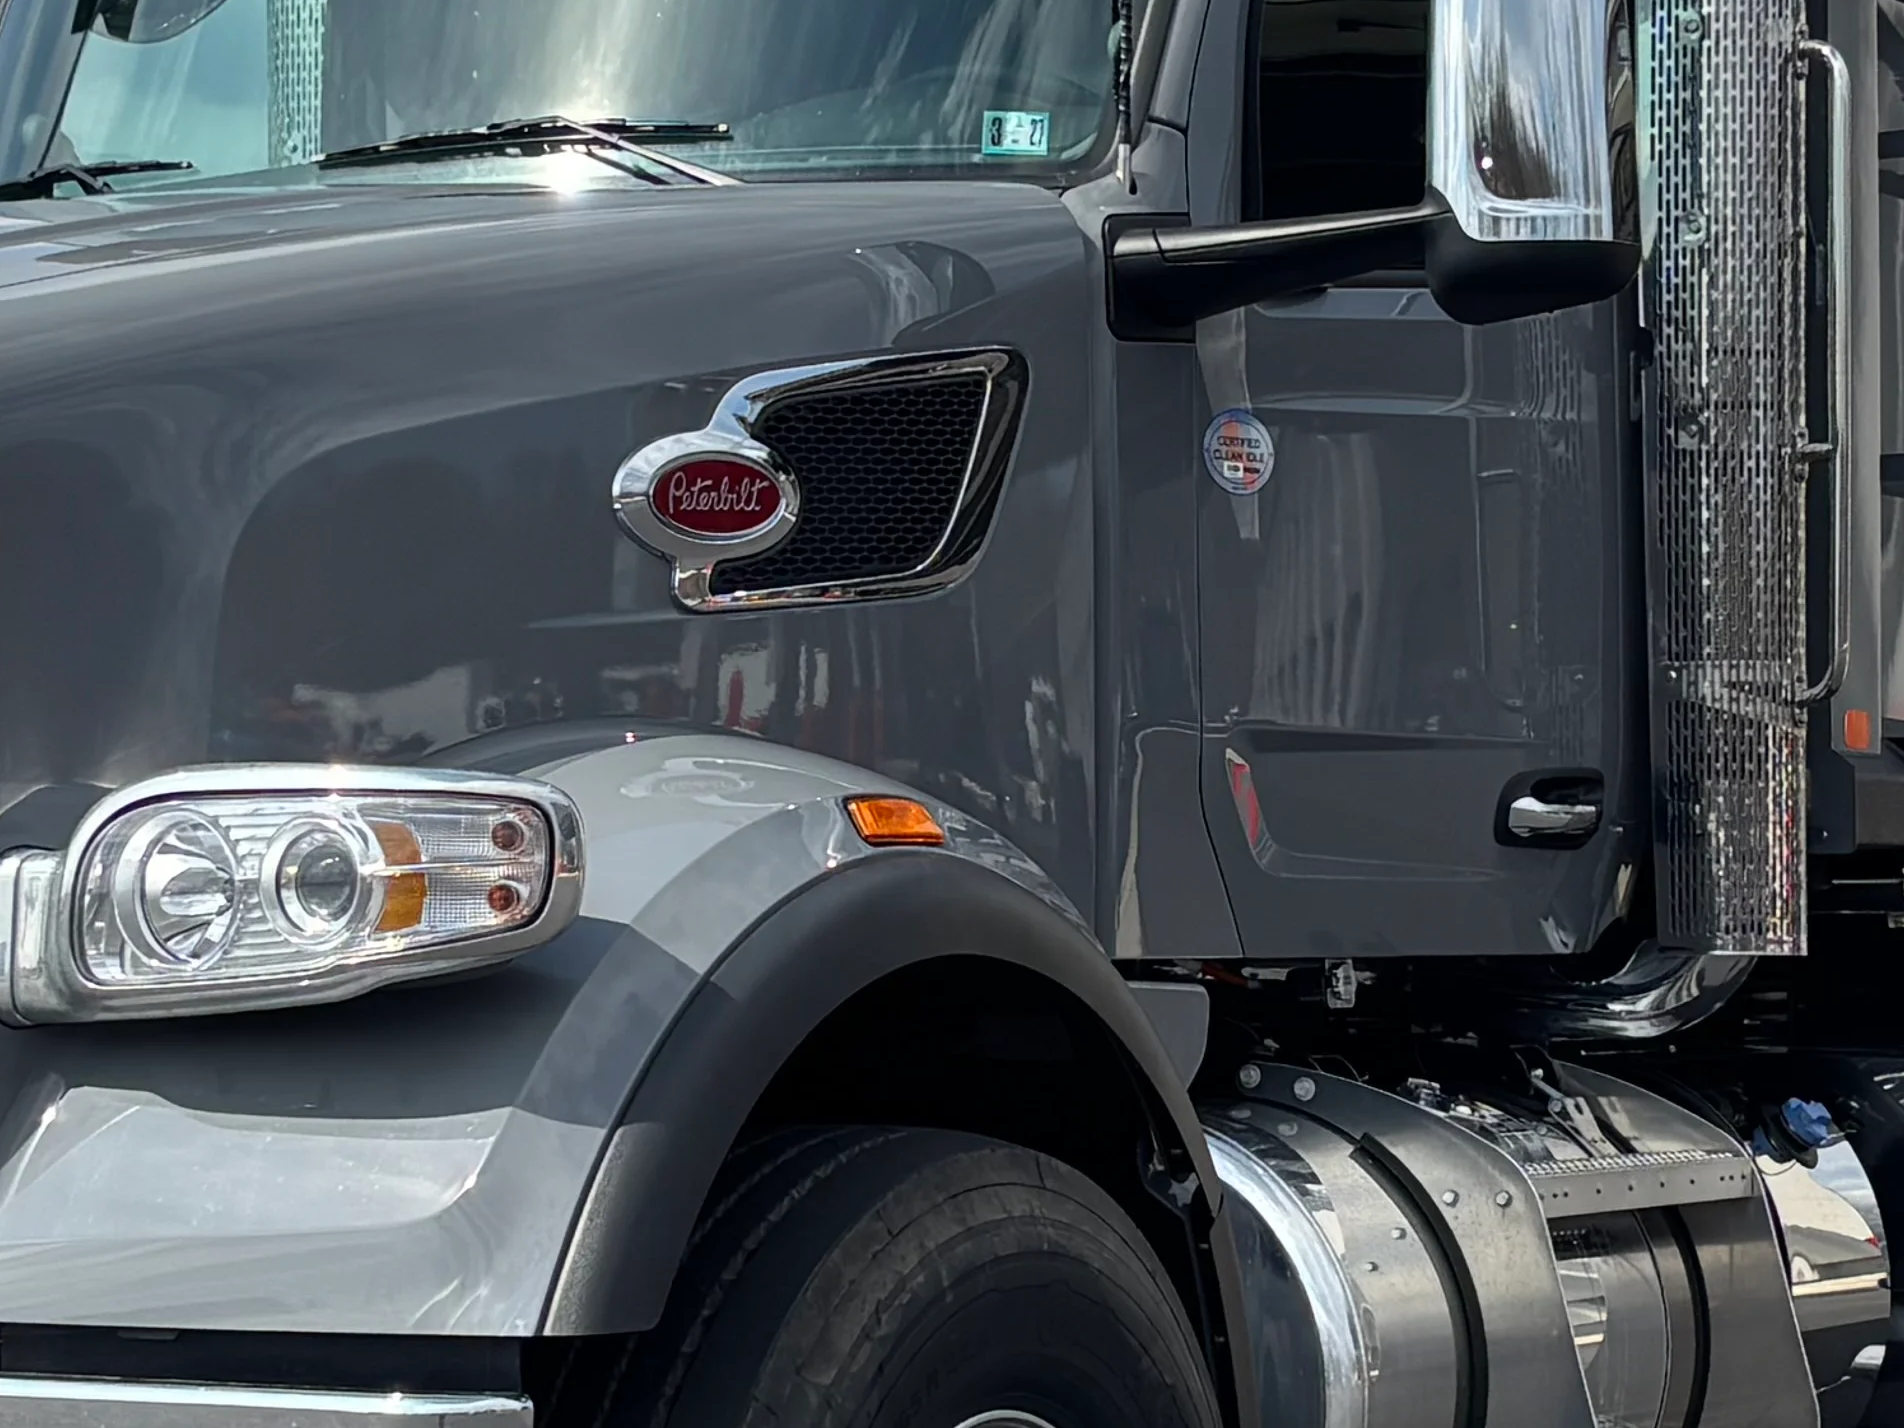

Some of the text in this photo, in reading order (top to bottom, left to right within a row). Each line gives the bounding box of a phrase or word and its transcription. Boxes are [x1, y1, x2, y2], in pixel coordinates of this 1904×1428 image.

[990, 116, 1003, 147] 3
[1216, 435, 1261, 449] CERTIFIED
[1213, 448, 1243, 463] CLEAN
[668, 470, 770, 515] Peterbilt
